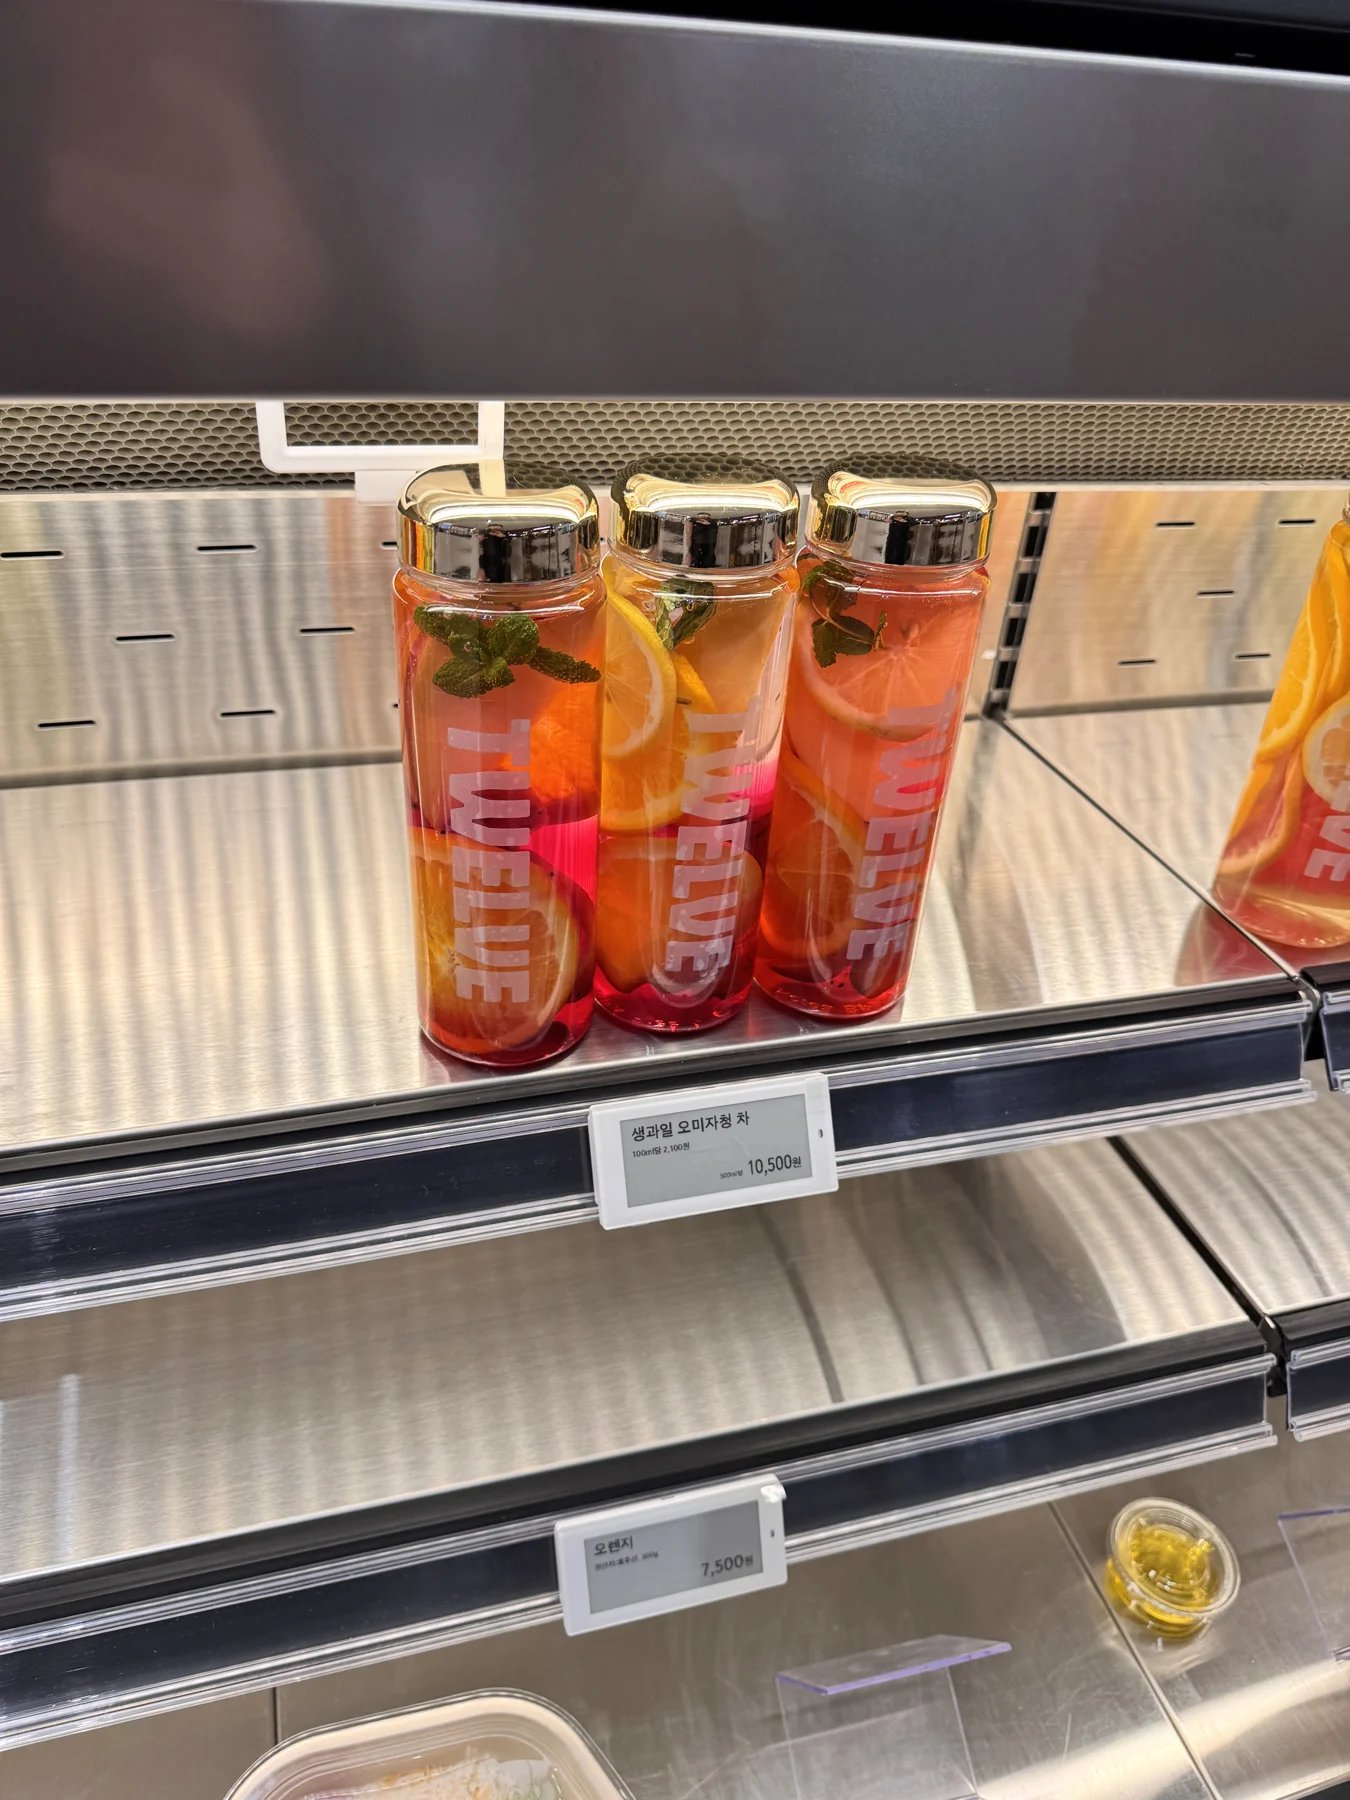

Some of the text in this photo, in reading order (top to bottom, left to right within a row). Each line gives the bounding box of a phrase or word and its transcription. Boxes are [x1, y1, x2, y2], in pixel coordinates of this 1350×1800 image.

[665, 695, 762, 974] TWELVE
[846, 685, 955, 961] TWELVE
[448, 718, 530, 1003] TWELVE
[632, 1110, 750, 1142] 생과일 오미자청 차
[632, 1142, 690, 1158] 100ml당 2,100원
[748, 1154, 802, 1176] 10,500원
[594, 1536, 634, 1556] 오렌지
[701, 1554, 754, 1578] 7,500원
